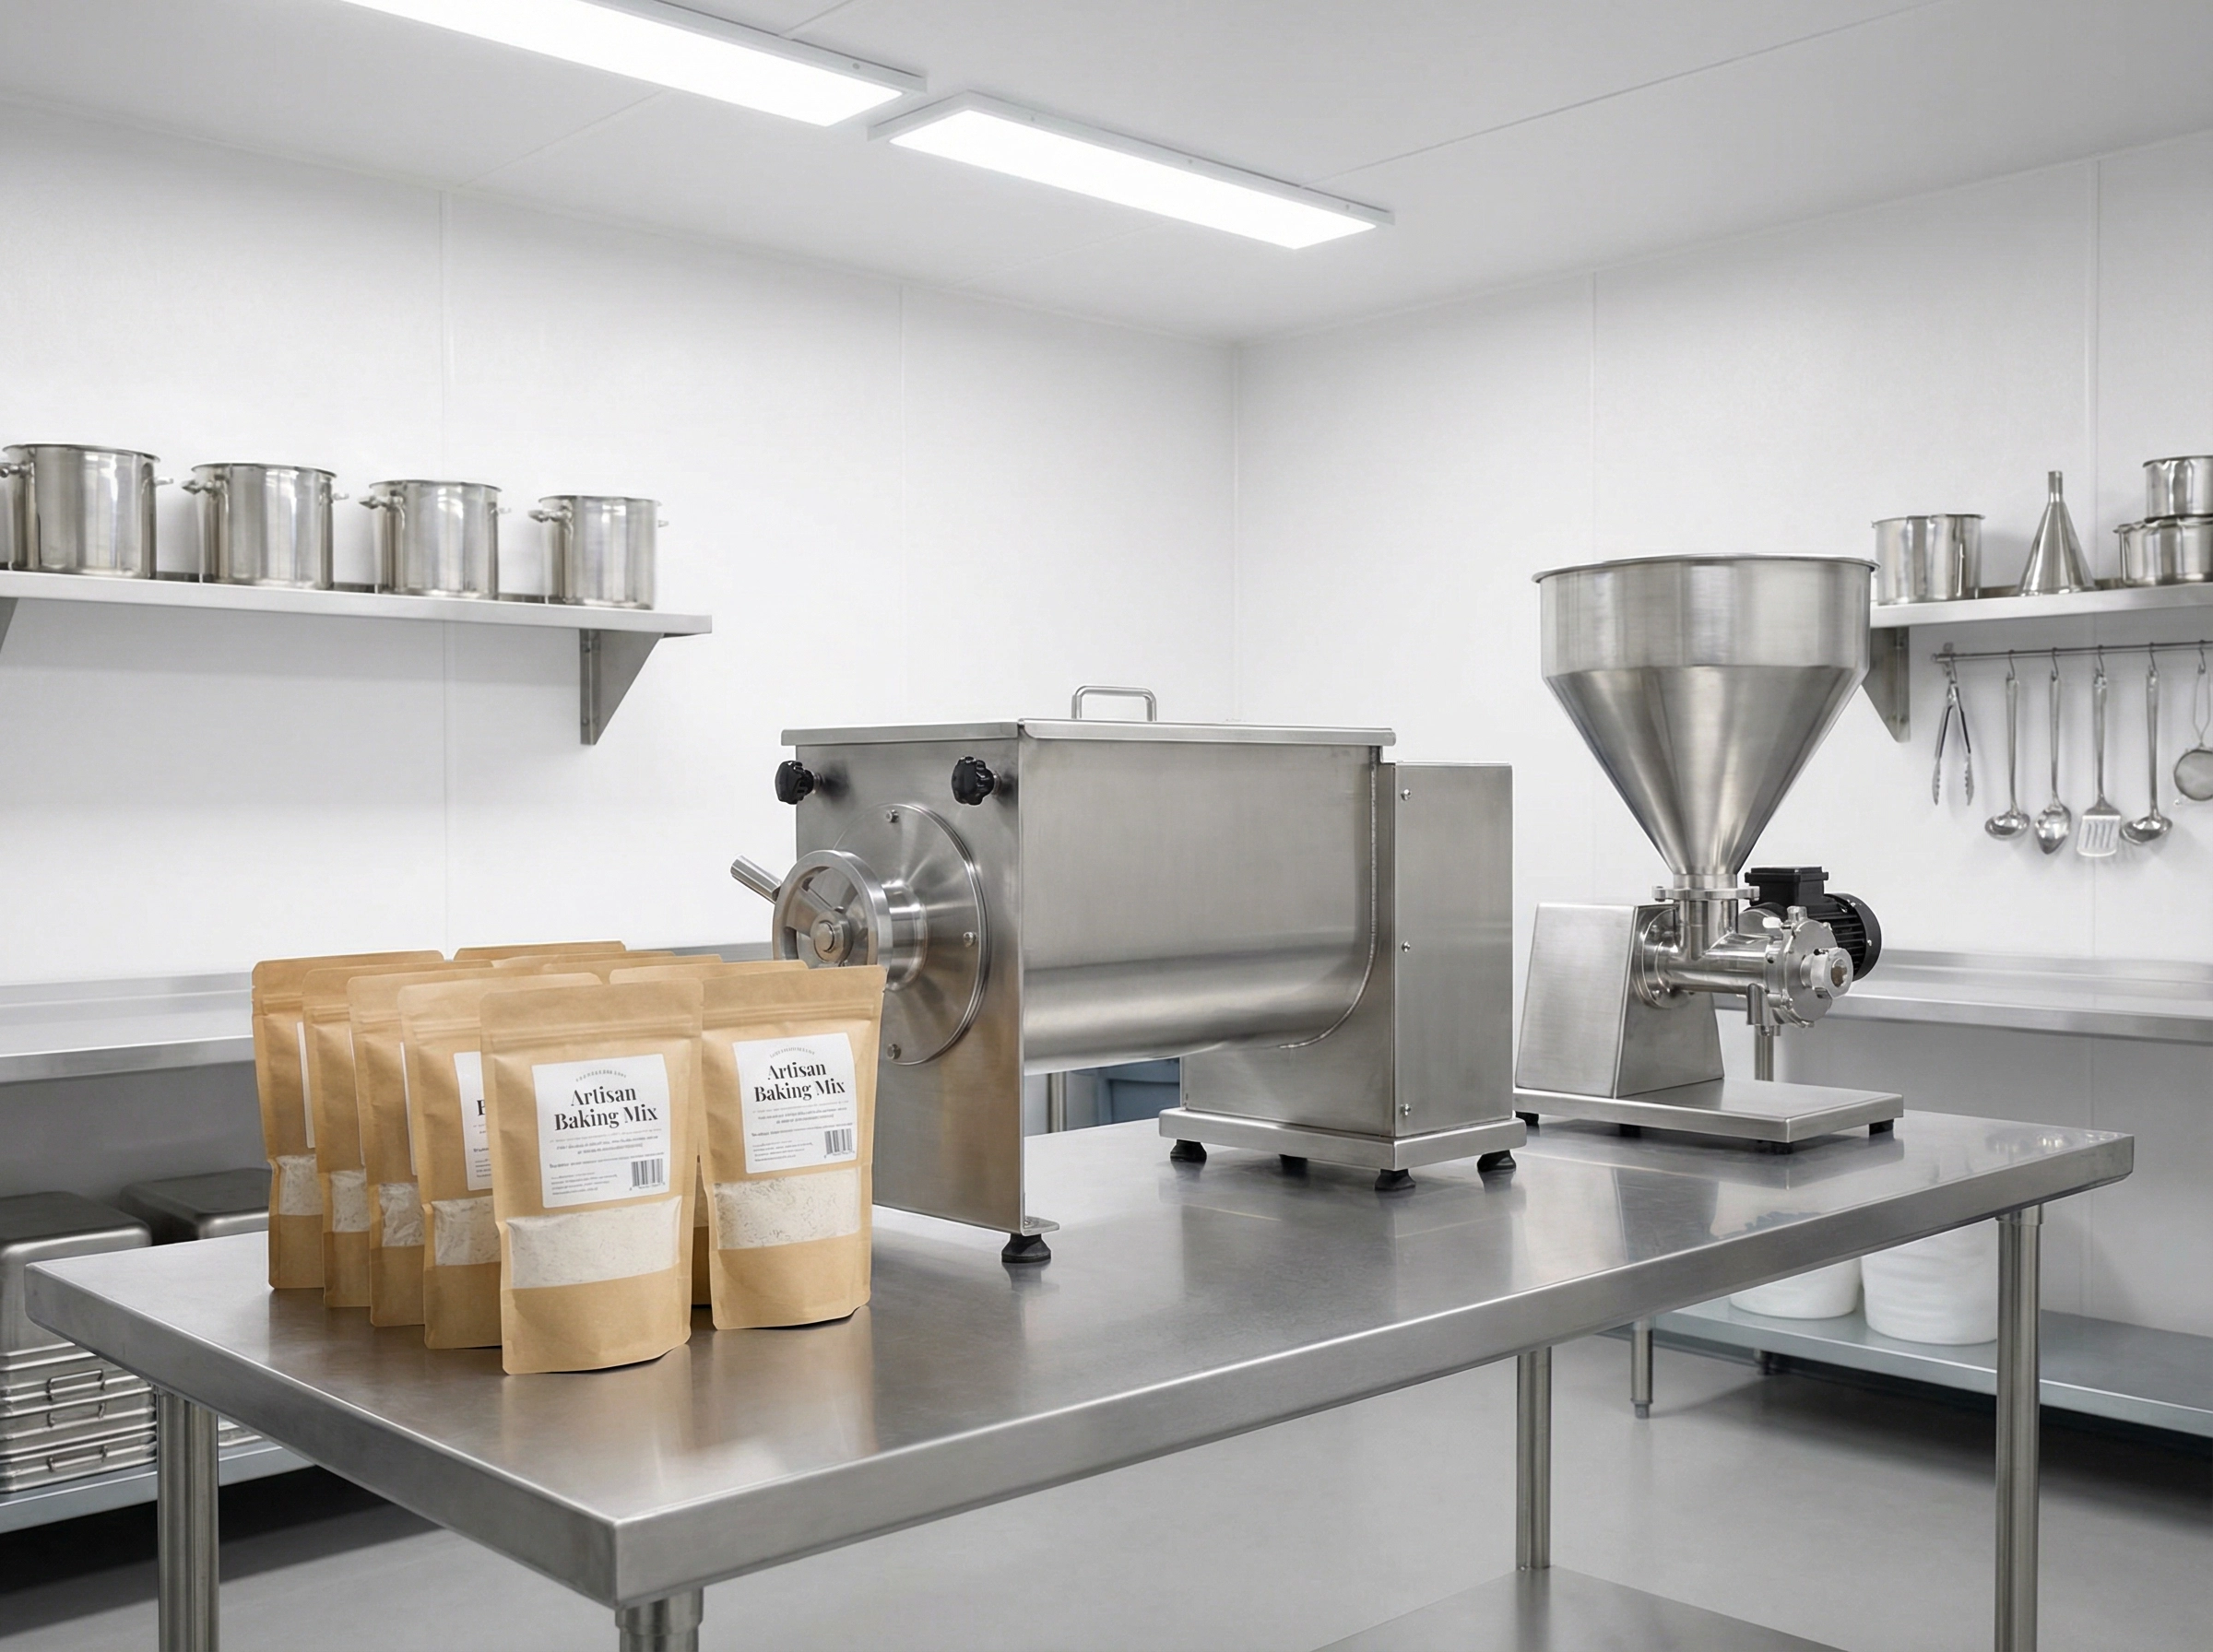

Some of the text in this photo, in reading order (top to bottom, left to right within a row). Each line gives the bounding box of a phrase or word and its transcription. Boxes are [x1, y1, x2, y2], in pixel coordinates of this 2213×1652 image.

[767, 1062, 826, 1080] Artisan
[571, 1086, 636, 1106] Artisan
[754, 1078, 846, 1102] Baking Mix
[554, 1103, 658, 1131] Baking Mix
